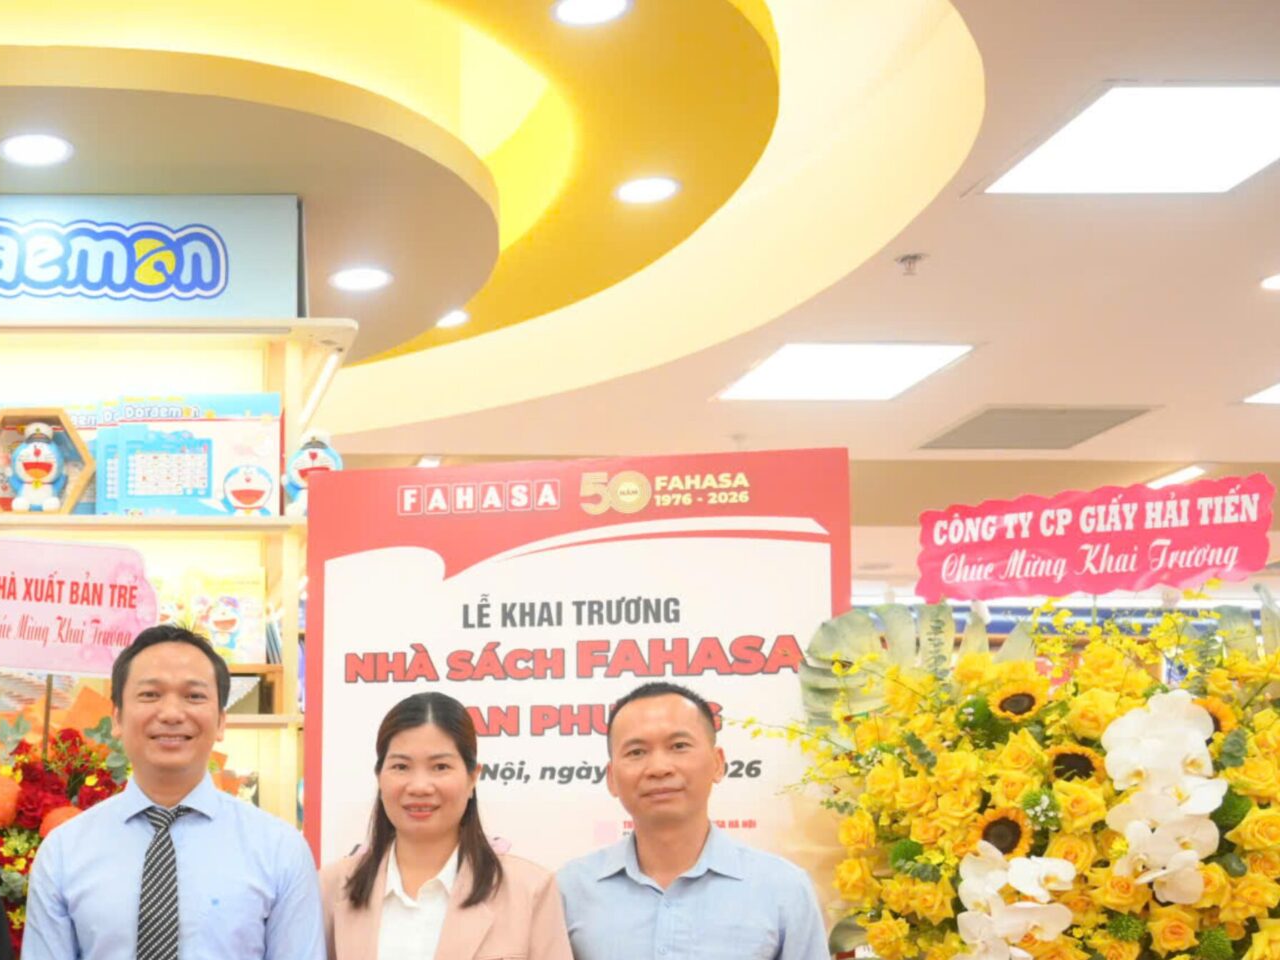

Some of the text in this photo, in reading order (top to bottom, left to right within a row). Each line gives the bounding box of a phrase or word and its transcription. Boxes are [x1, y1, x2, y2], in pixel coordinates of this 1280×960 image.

[402, 482, 558, 513] FAHASA
[579, 470, 653, 516] 50
[654, 472, 750, 491] FAHASA
[654, 493, 693, 507] 1976
[707, 491, 750, 505] 2026
[932, 483, 1261, 546] CÔNG TY CP GIẤY HẢI TIẾN
[941, 537, 1240, 585] Chúc Mừng Khai Trương
[22, 571, 65, 604] XUẤT
[69, 571, 104, 606] BẢN
[109, 575, 138, 609] TRẺ
[462, 593, 681, 629] LỄ KHAI TRƯƠNG
[55, 614, 86, 645] Khai
[344, 634, 807, 683] NHÀ SÁCH FAHASA
[539, 761, 608, 785] ngày
